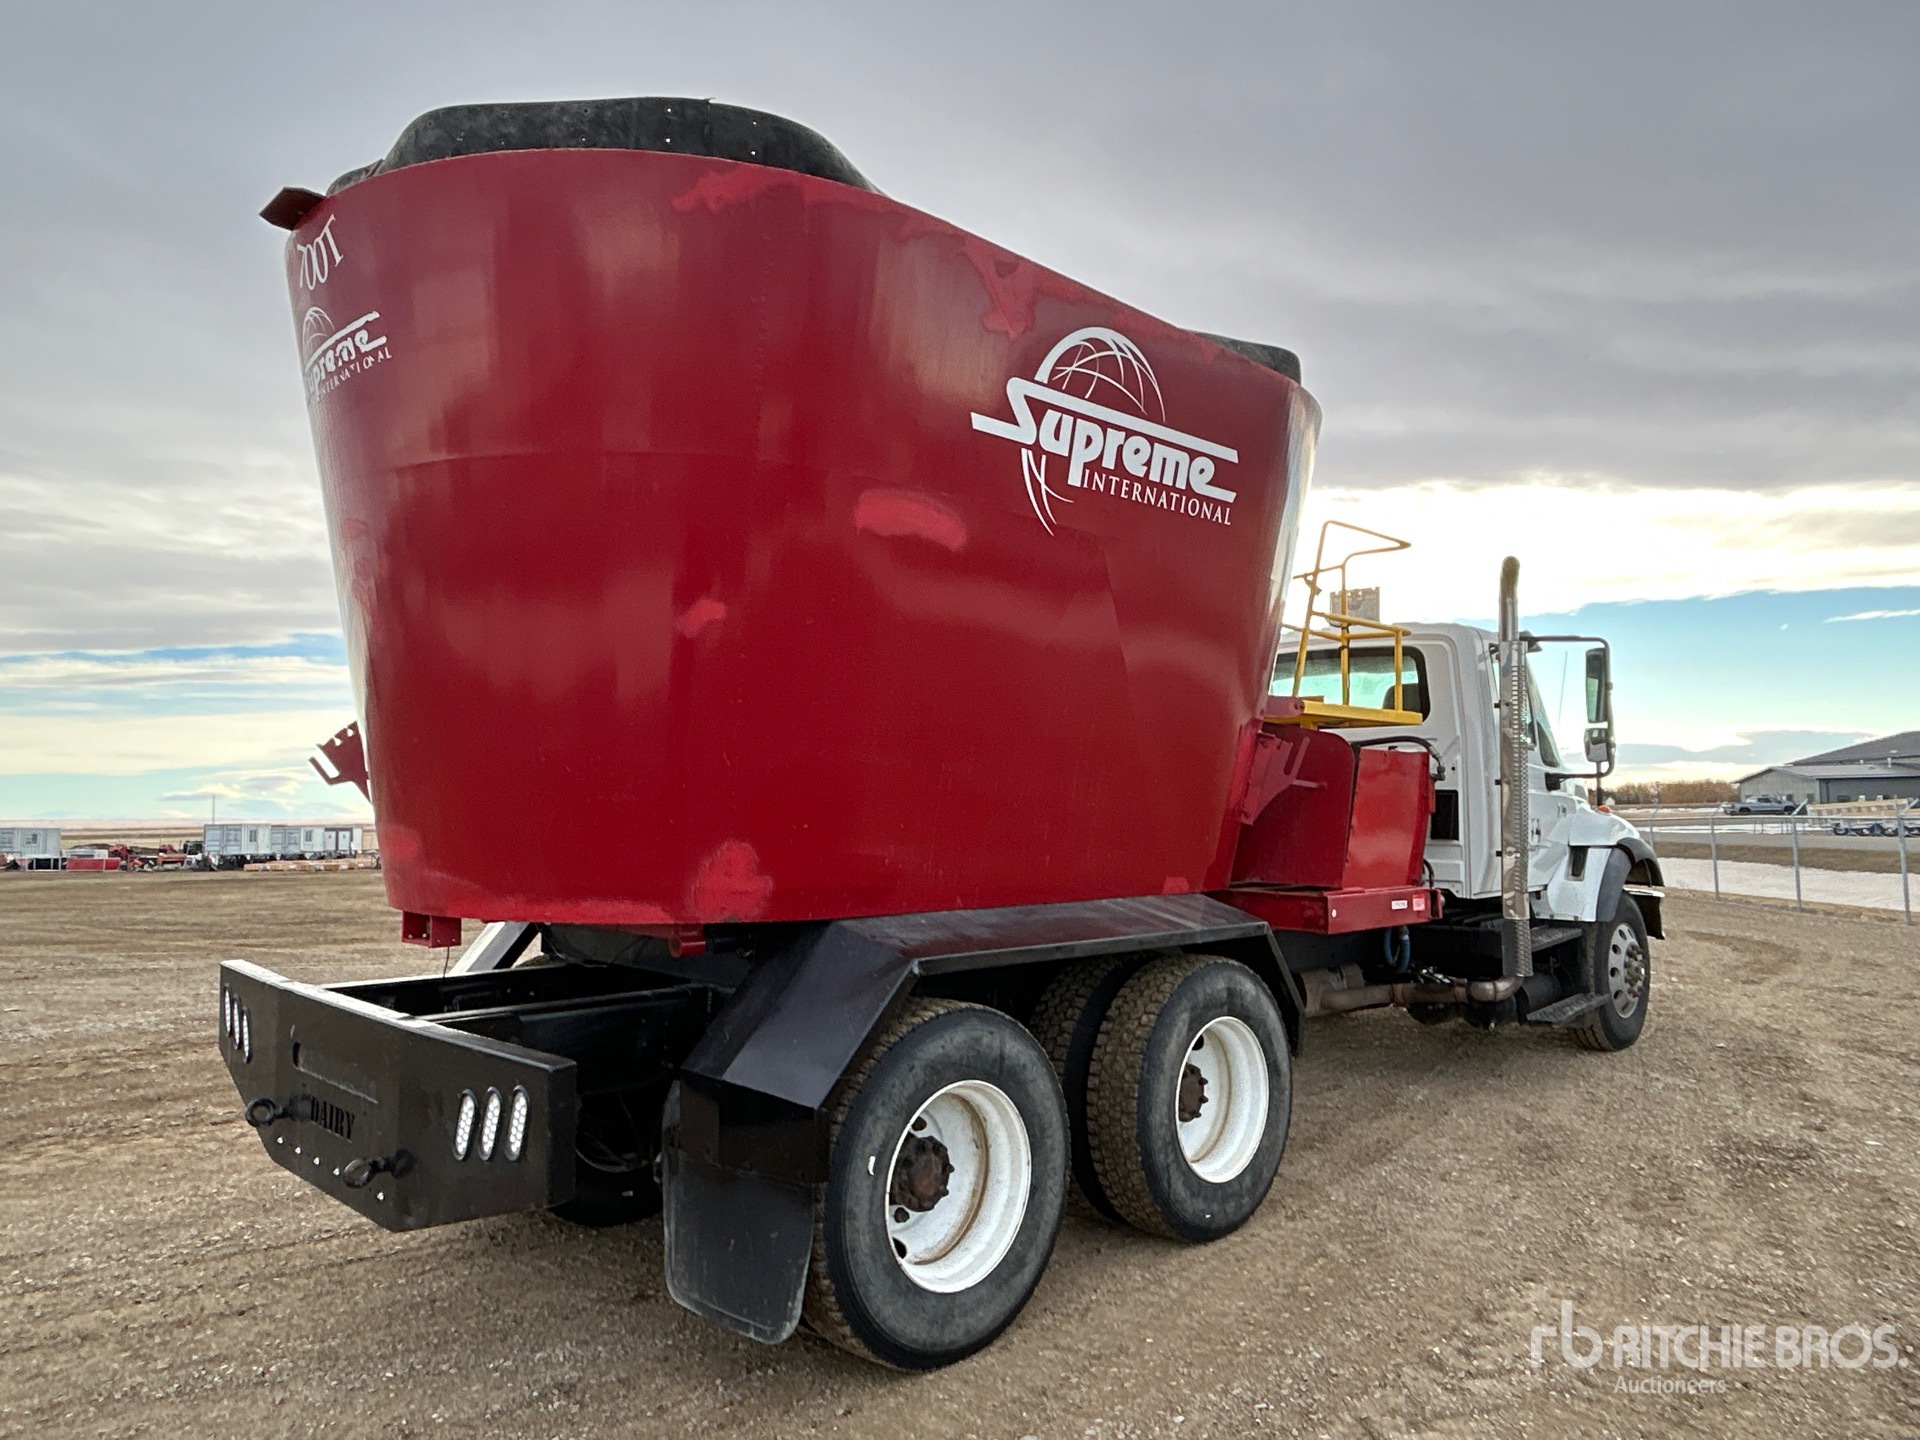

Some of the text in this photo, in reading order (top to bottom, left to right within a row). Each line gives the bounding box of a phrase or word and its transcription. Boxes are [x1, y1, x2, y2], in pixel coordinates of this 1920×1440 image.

[297, 213, 344, 290] 700T
[970, 376, 1240, 503] Supreme
[1083, 468, 1232, 526] INTERNATIONAL
[310, 1096, 355, 1140] DAIRY
